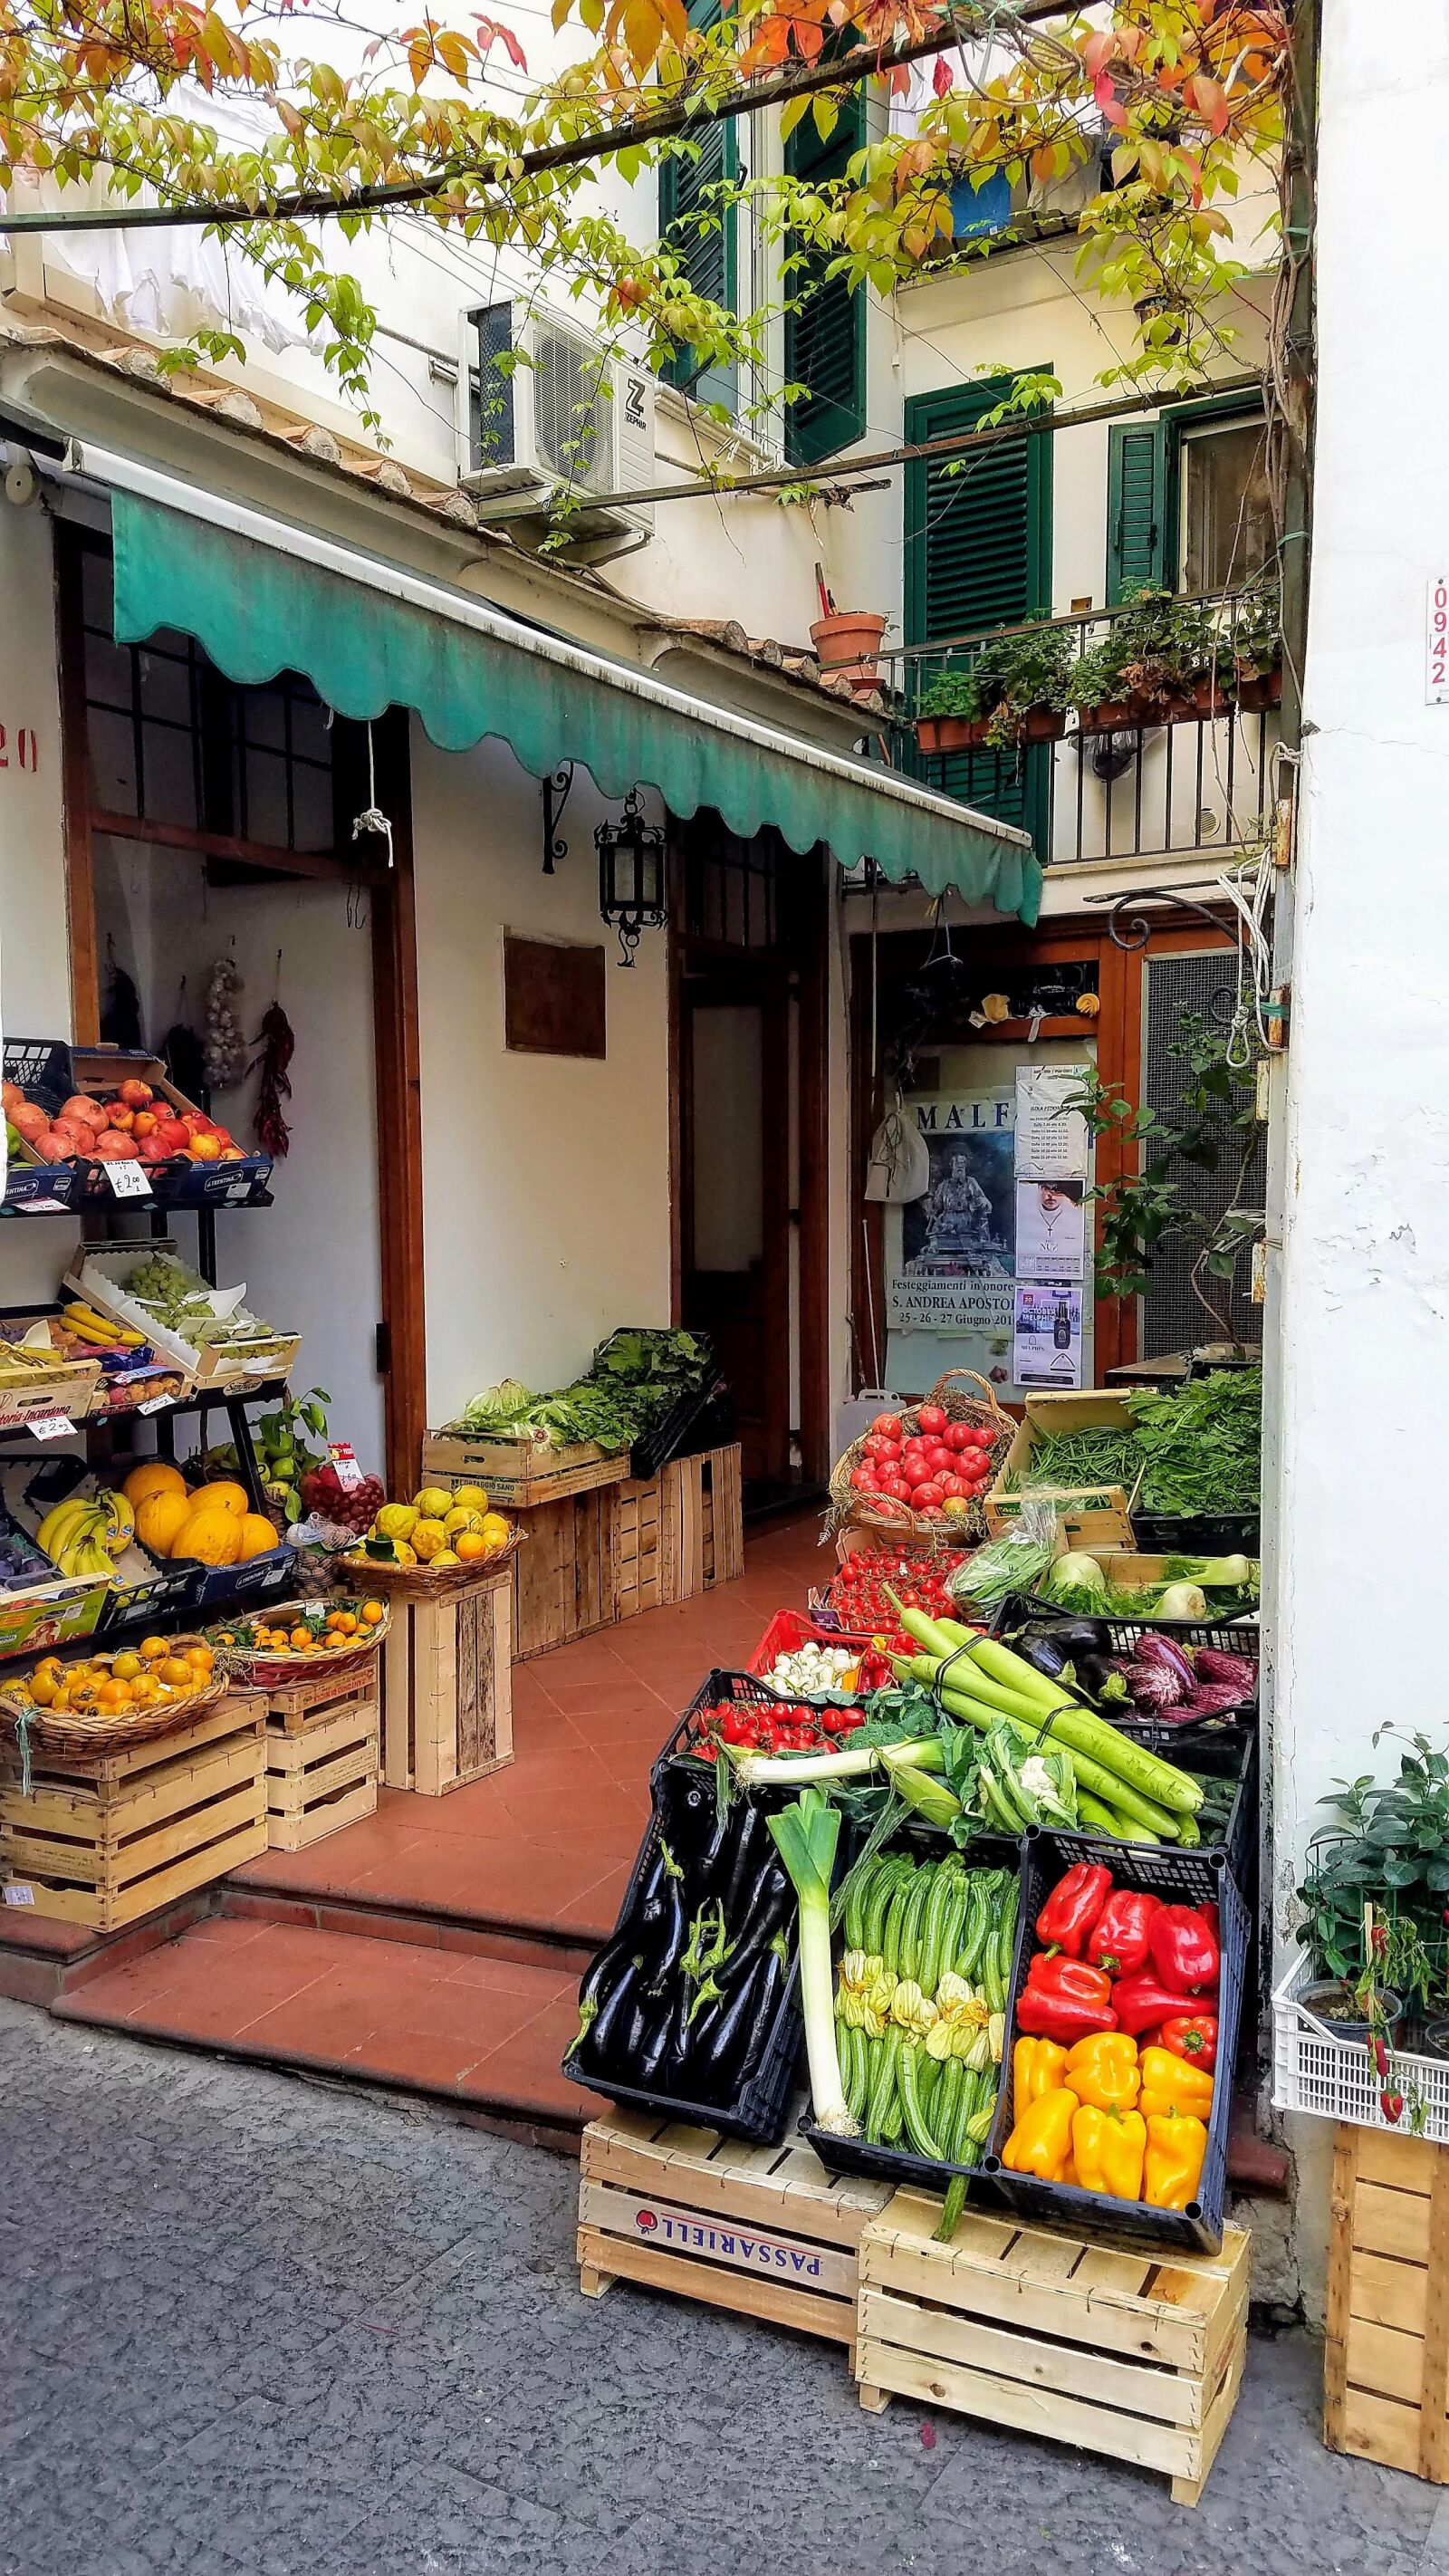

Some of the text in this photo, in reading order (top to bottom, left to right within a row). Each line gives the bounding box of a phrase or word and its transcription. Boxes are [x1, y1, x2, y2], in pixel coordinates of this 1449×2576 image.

[624, 412, 647, 432] ZEPHIR
[916, 1102, 1016, 1130] MALF
[892, 1279, 1014, 1293] Festeggiamenti in onore
[892, 1295, 903, 1308] S.
[906, 1296, 956, 1310] ANDREA
[1022, 1307, 1057, 1315] OCTOBER
[899, 1312, 911, 1323] 25
[919, 1312, 932, 1323] 26
[940, 1313, 953, 1323] 27
[955, 1314, 992, 1327] Giugno
[993, 1314, 1013, 1325] 201
[496, 1483, 515, 1492] SANO
